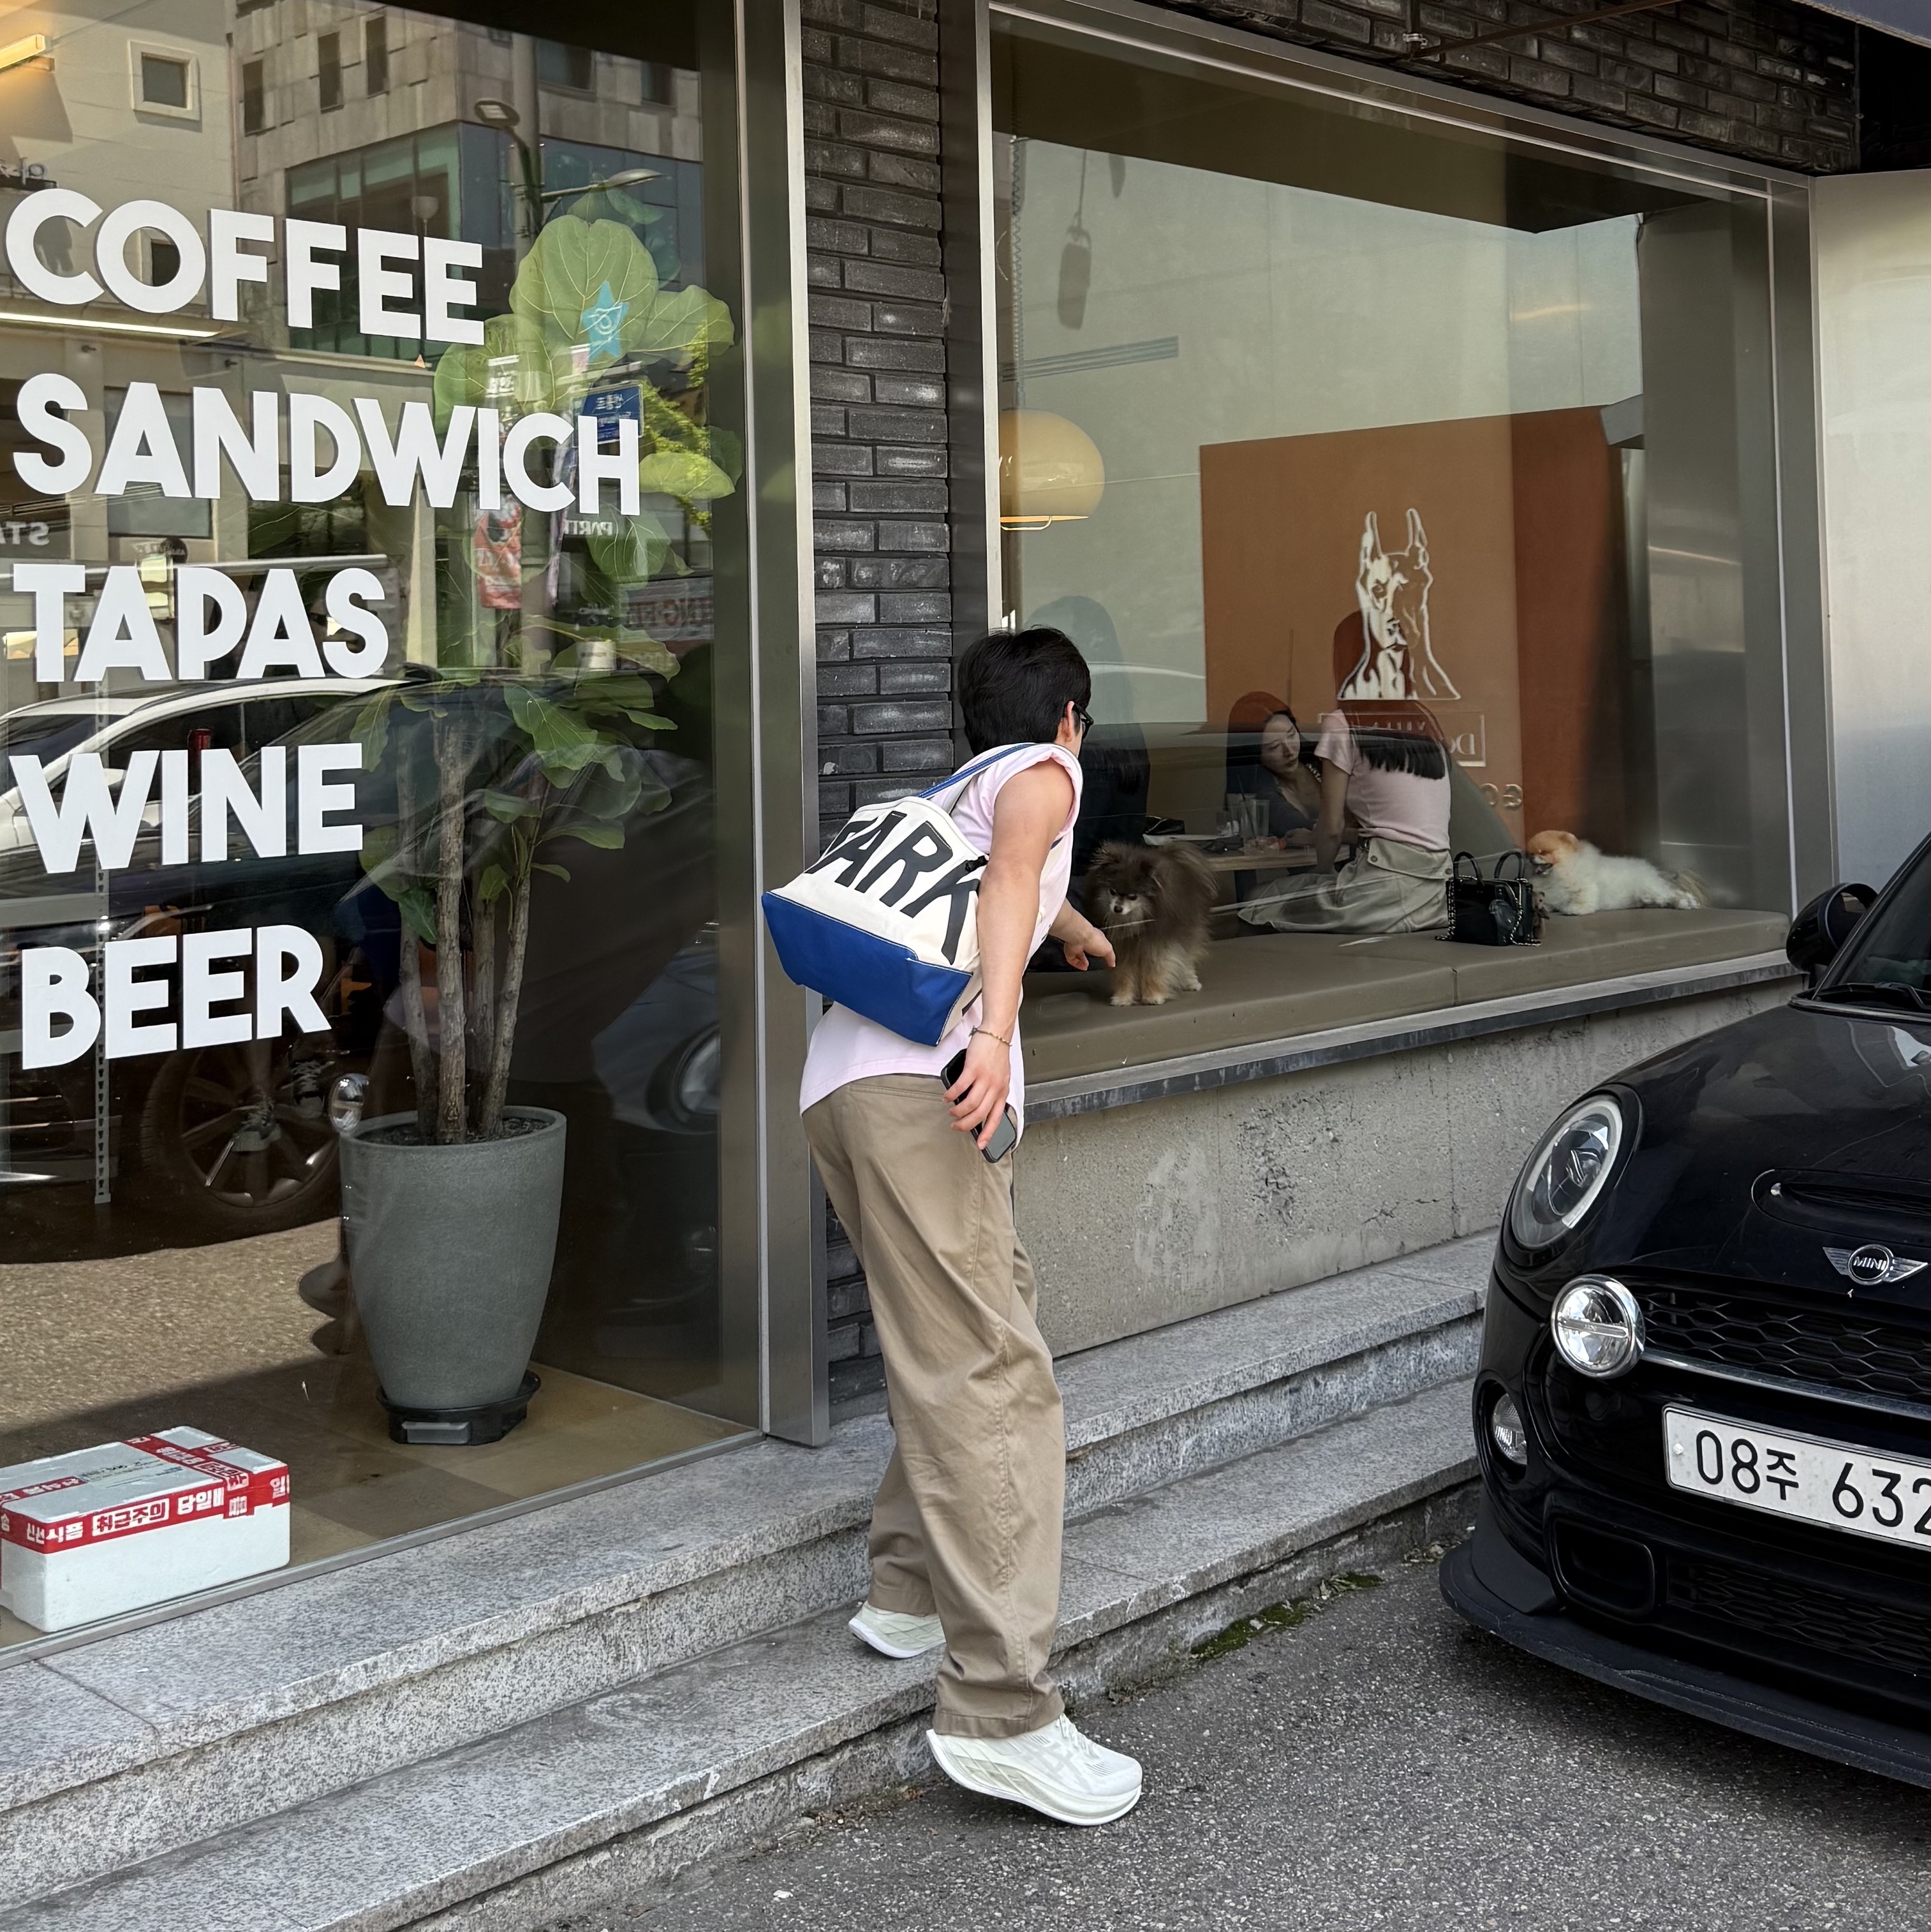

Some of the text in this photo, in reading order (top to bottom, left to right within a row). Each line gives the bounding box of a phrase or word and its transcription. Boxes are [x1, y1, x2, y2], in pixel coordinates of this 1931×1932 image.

[6, 188, 484, 345] COFFEE
[13, 373, 640, 516] SANDWICH
[13, 563, 389, 682] TAPAS
[10, 742, 364, 874] WINE
[22, 925, 332, 1070] BEER
[1853, 1256, 1887, 1271] MINI
[1696, 1429, 1799, 1501] 08주
